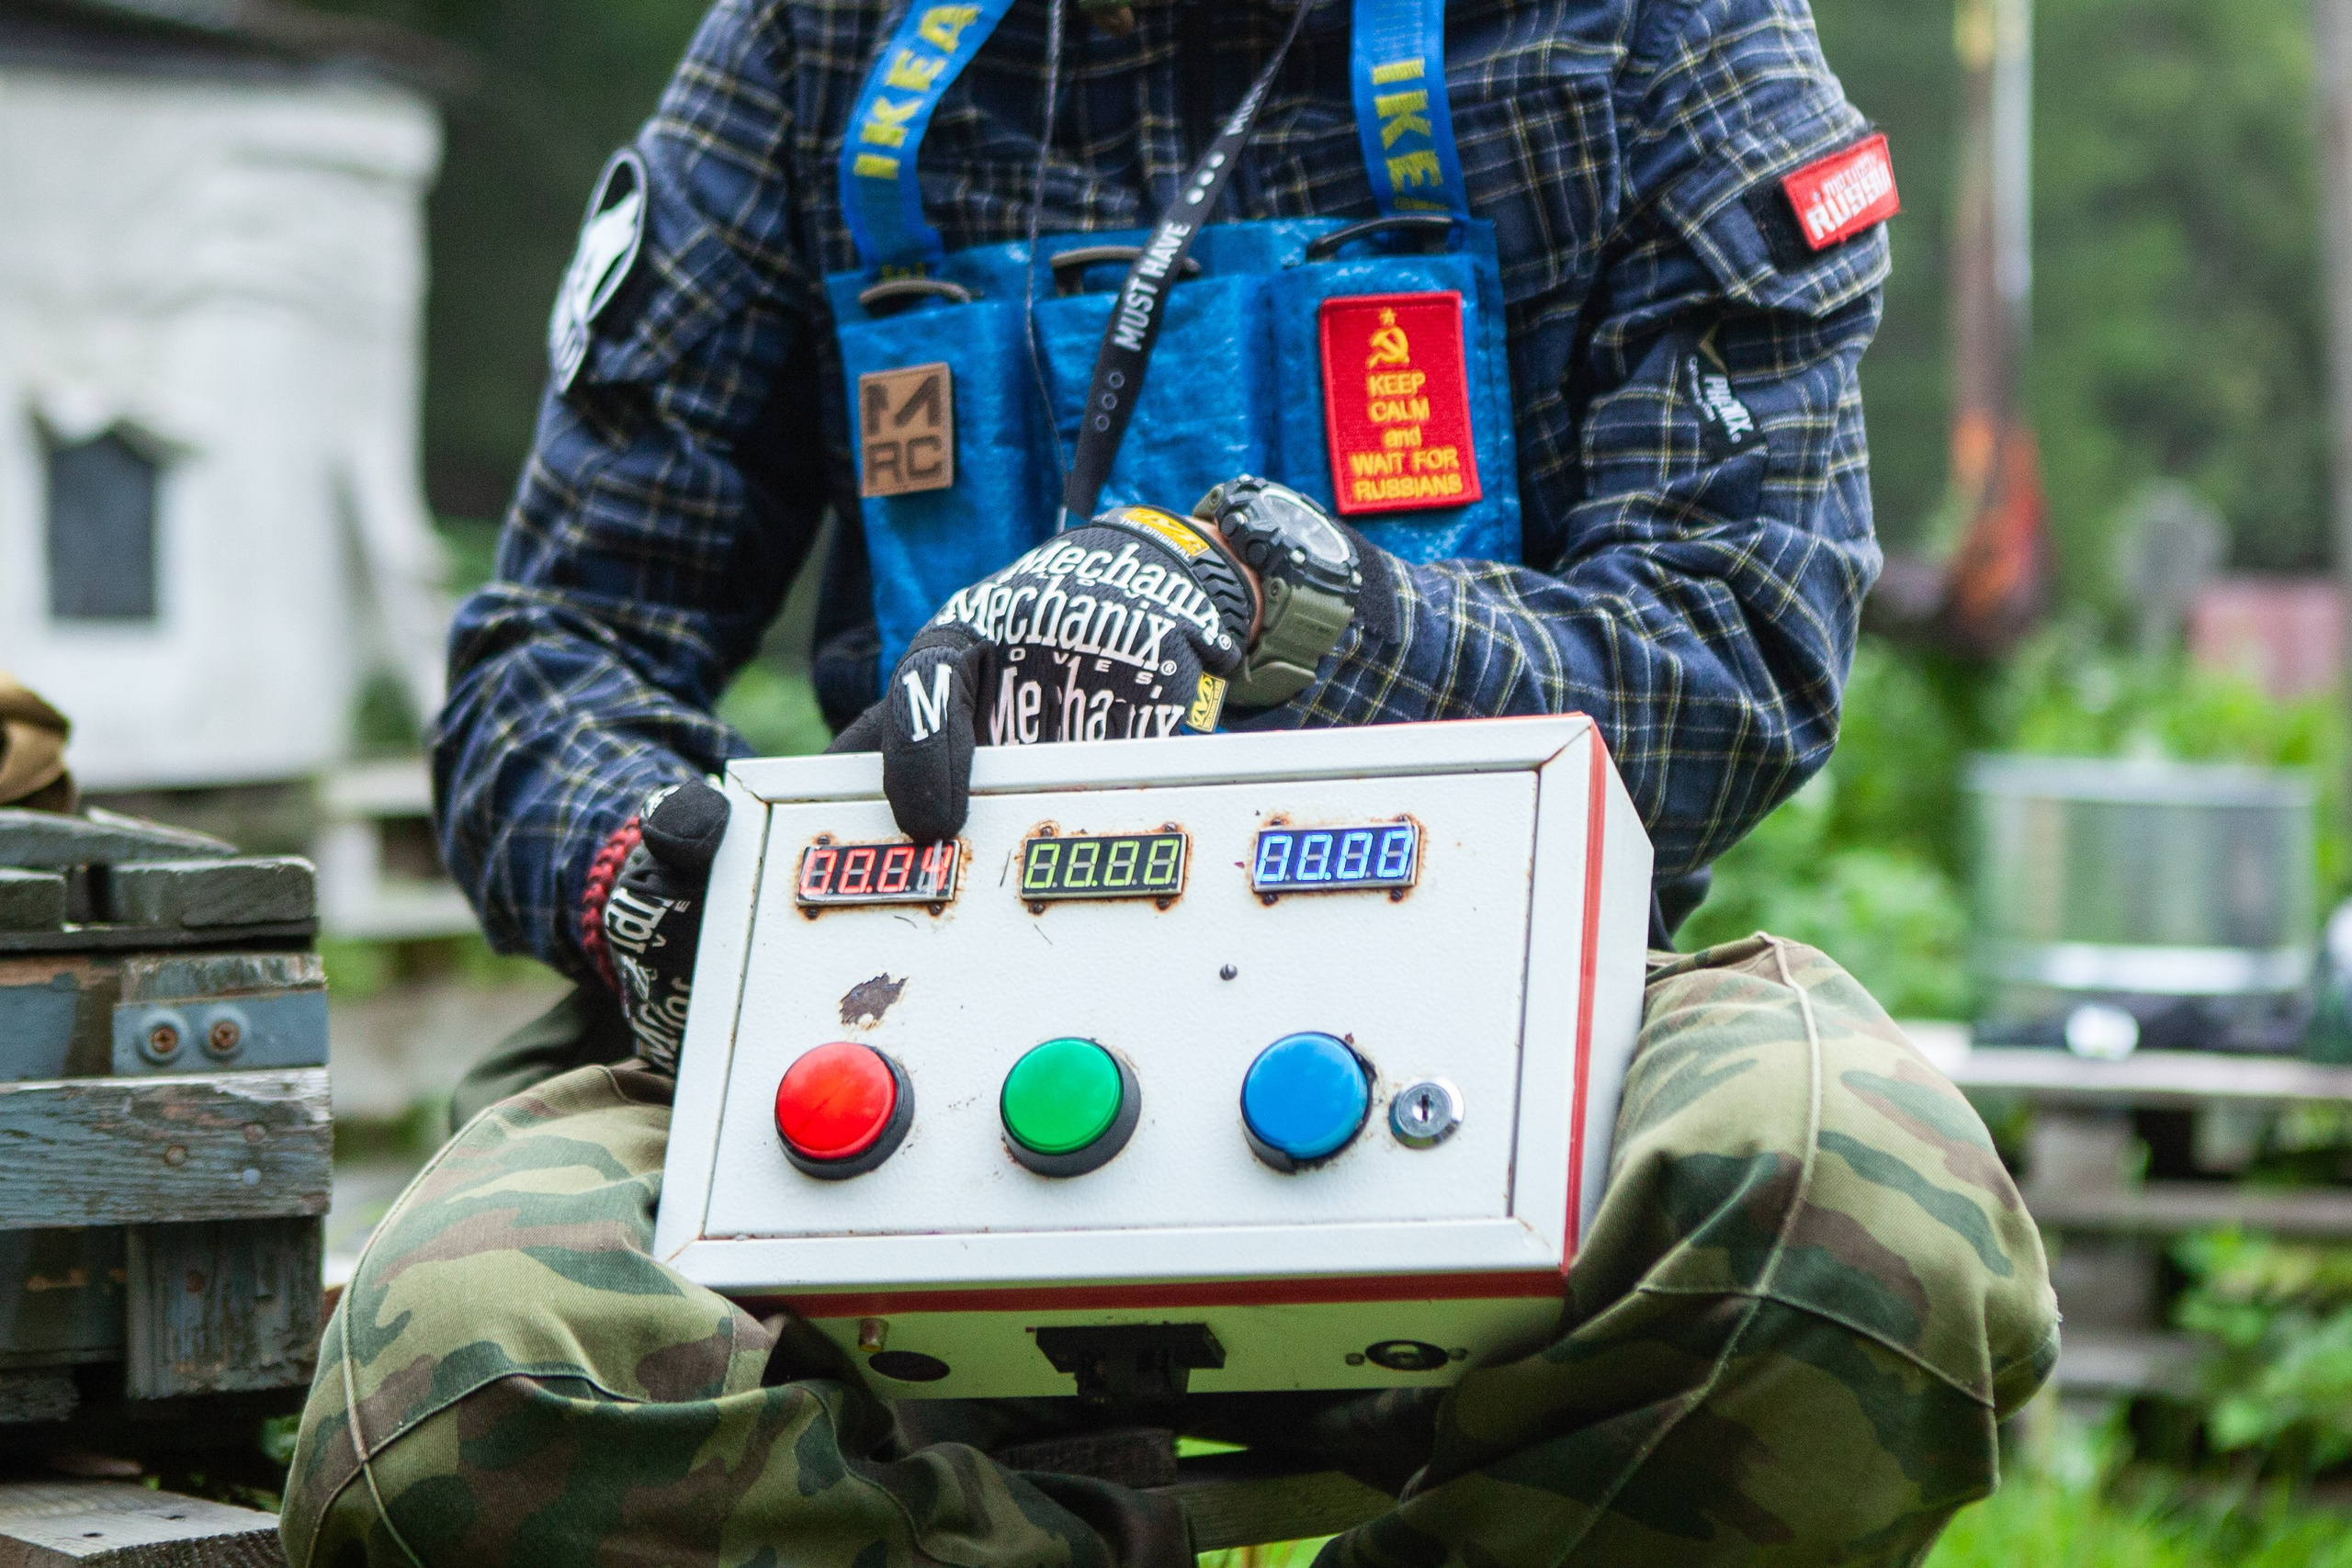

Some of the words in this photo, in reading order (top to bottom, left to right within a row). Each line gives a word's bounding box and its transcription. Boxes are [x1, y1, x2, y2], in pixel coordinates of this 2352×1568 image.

[853, 6, 980, 180] IKEA
[1113, 277, 1159, 352] MUST
[1138, 221, 1192, 278] HAVE
[1368, 371, 1426, 397] KEEP
[1368, 398, 1430, 423] CALM
[1384, 425, 1421, 448] and
[1351, 452, 1405, 476] WAIT
[1412, 447, 1459, 472] FOR
[1352, 474, 1463, 502] RUSSIANS
[1119, 515, 1141, 530] THE
[1143, 524, 1192, 562] ORIGINAL
[989, 655, 1186, 746] Mehaix
[799, 845, 954, 895] 00.04
[1024, 840, 1180, 888] 00.00
[1257, 830, 1413, 882] 00.00
